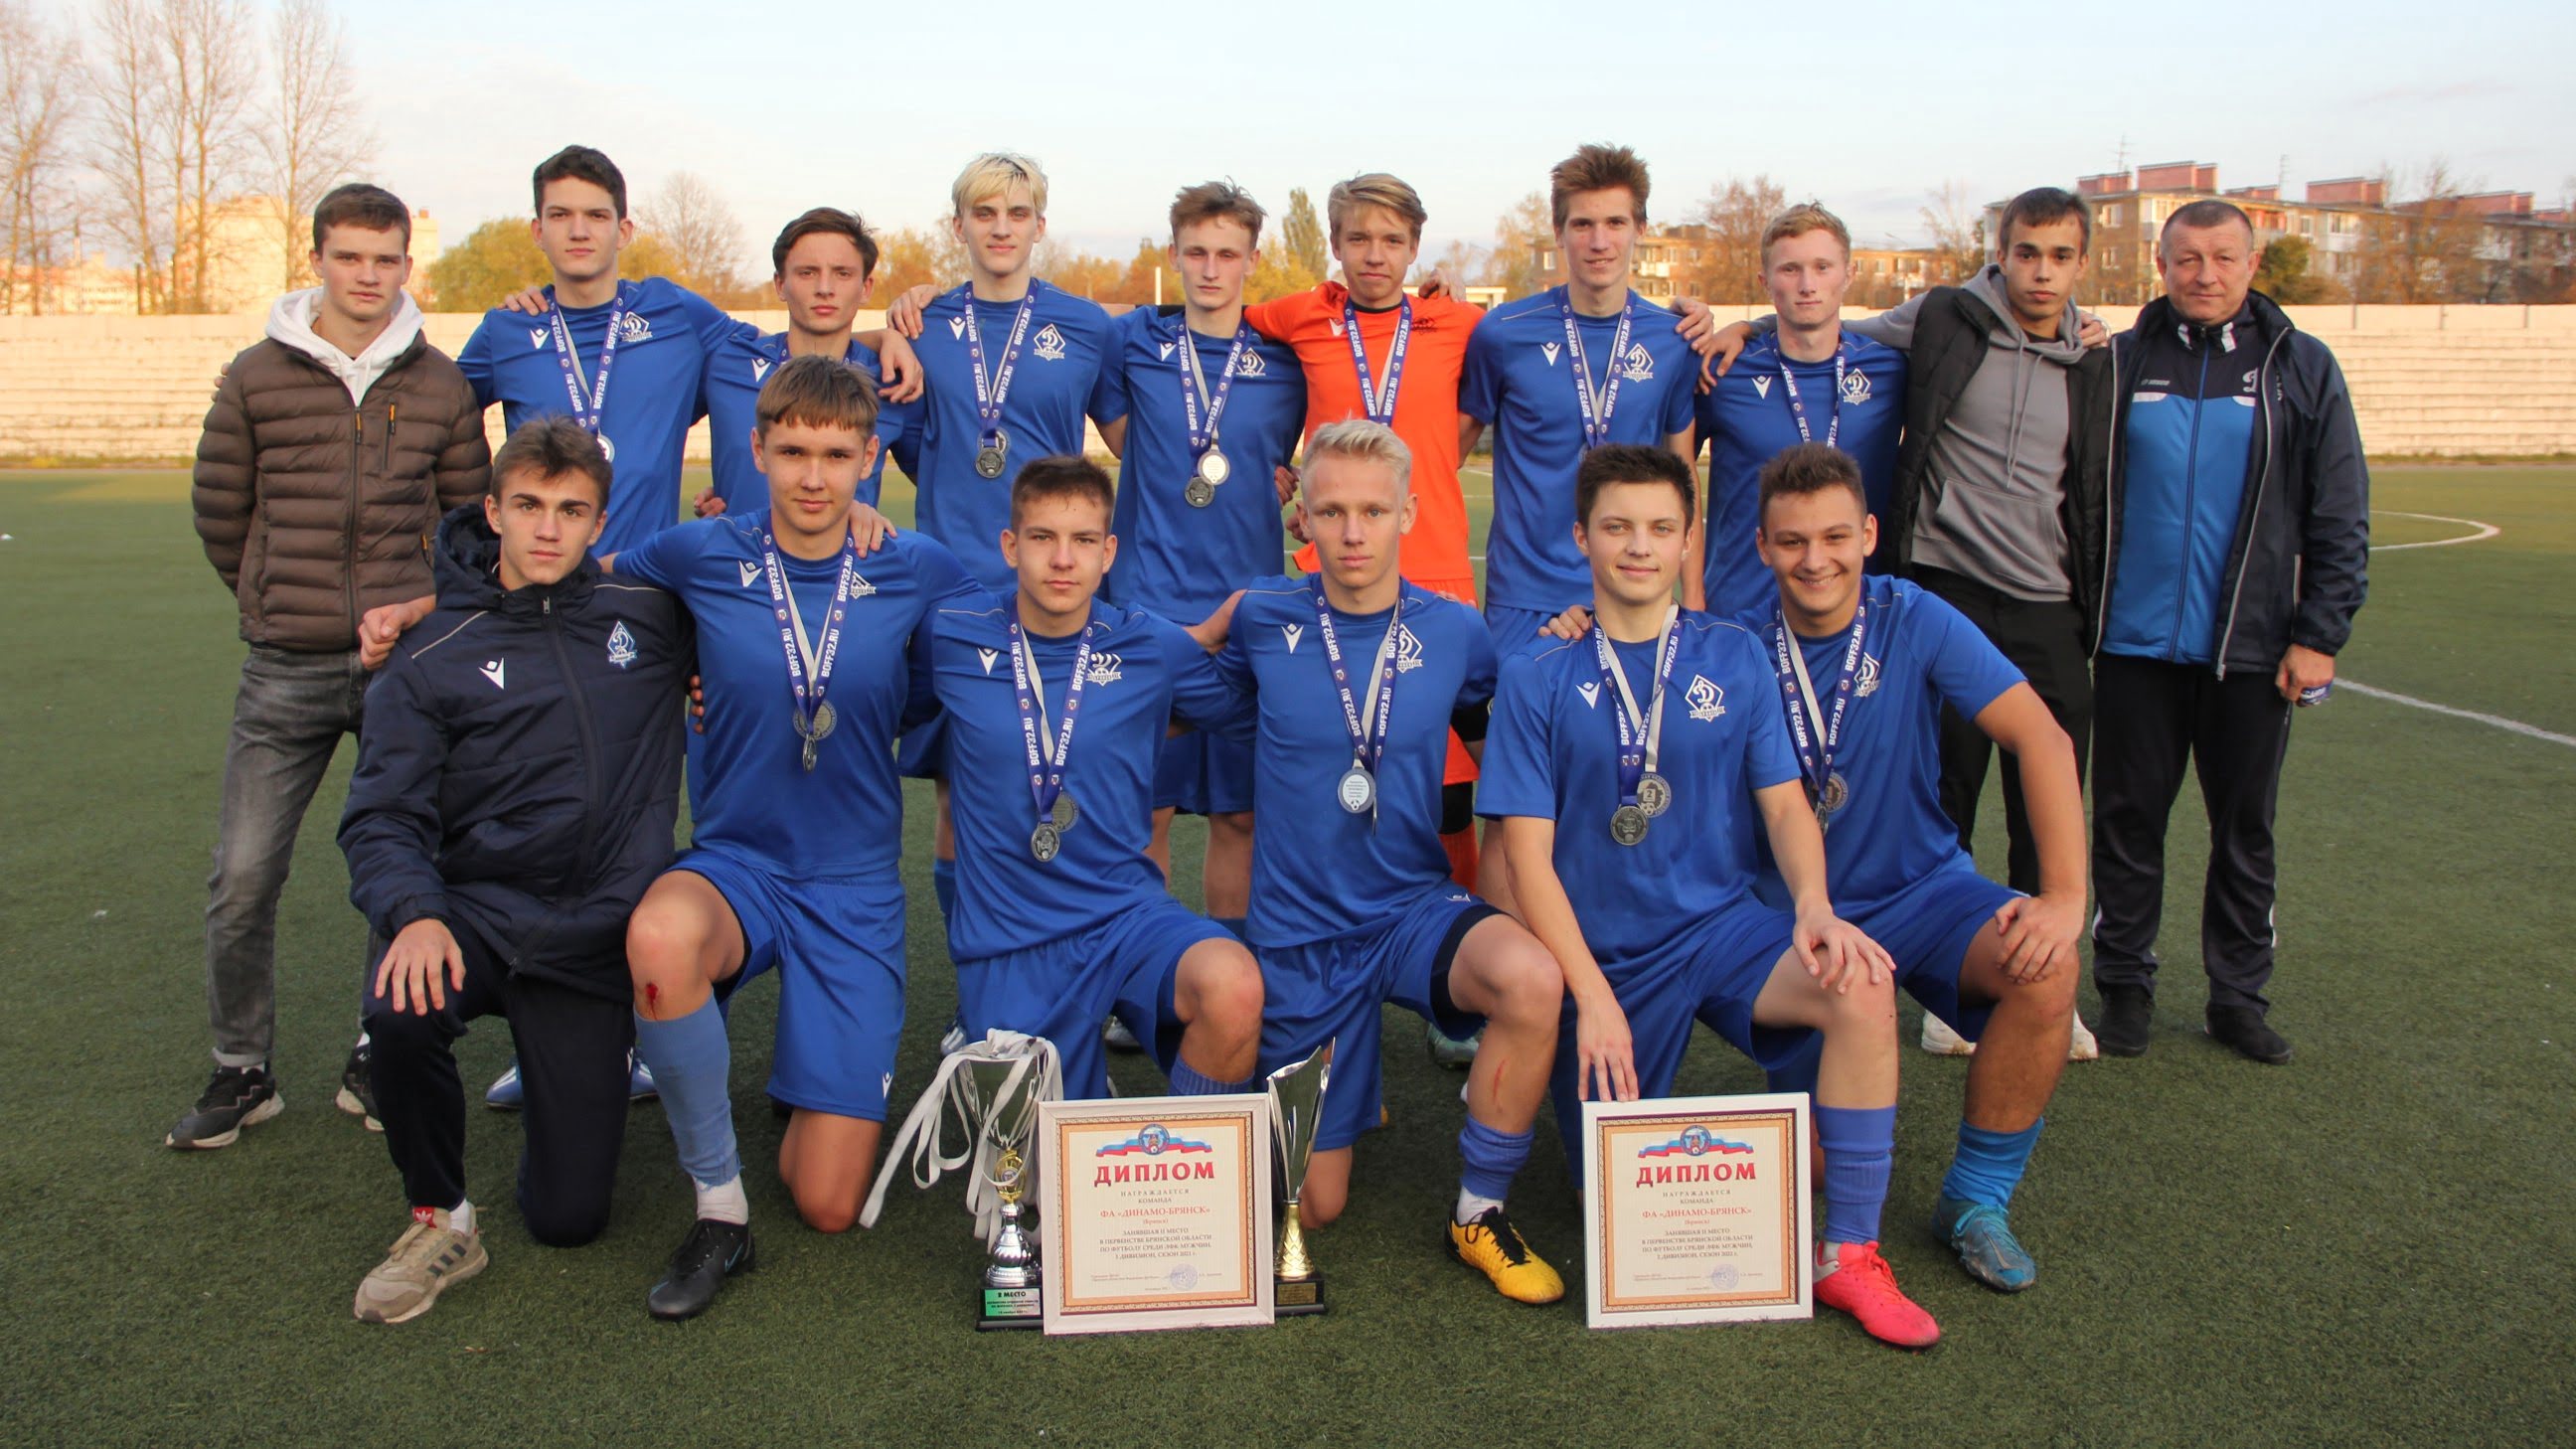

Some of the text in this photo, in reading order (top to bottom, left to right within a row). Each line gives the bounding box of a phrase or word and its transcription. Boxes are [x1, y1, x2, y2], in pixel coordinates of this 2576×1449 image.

[551, 315, 566, 353] BOFF32.RU
[606, 311, 622, 350] BOFF32.RU
[965, 304, 978, 342] BOFF32.RU
[1014, 308, 1032, 346] BOFF32.RU
[1348, 320, 1364, 358] BOFF32.RU
[1395, 319, 1410, 357] BOFF32.RU
[1564, 318, 1579, 357] BOFF32.RU
[1616, 320, 1631, 359] BOFF32.RU
[1179, 336, 1191, 372] BOFF32.RU
[1224, 342, 1242, 378] BOFF32.RU
[564, 374, 583, 412] BOFF32.RU
[593, 371, 608, 409] BOFF32.RU
[974, 364, 987, 402] BOFF32.RU
[996, 366, 1014, 403] BOFF32.RU
[1362, 378, 1377, 416] BOFF32.RU
[1382, 378, 1398, 416] BOFF32.RU
[1576, 379, 1591, 418] BOFF32.RU
[1604, 379, 1619, 418] BOFF32.RU
[1186, 393, 1199, 431] BOFF32.RU
[1205, 397, 1222, 433] BOFF32.RU
[765, 553, 784, 600] BOFF32.RU
[837, 555, 854, 602] BOFF32.RU
[781, 628, 801, 677] BOFF32.RU
[821, 628, 840, 678] BOFF32.RU
[1320, 613, 1341, 662] BOFF32.RU
[1662, 636, 1679, 678] BOFF32.RU
[1776, 627, 1792, 675] BOFF32.RU
[1845, 624, 1863, 672] BOFF32.RU
[1012, 641, 1028, 690] BOFF32.RU
[1071, 643, 1091, 691] BOFF32.RU
[1341, 688, 1362, 736] BOFF32.RU
[1378, 687, 1392, 736] BOFF32.RU
[1789, 700, 1809, 747] BOFF32.RU
[1829, 698, 1846, 745] BOFF32.RU
[1023, 717, 1041, 766] BOFF32.RU
[1054, 718, 1074, 766] BOFF32.RU
[1094, 1161, 1214, 1188] ДИПЛОМ
[1120, 1189, 1191, 1198] НАГРАЖДАЕТСЯ
[1636, 1163, 1756, 1188] ДИПЛОМ
[1662, 1189, 1732, 1198] НАГРАЖДАЕТСЯ
